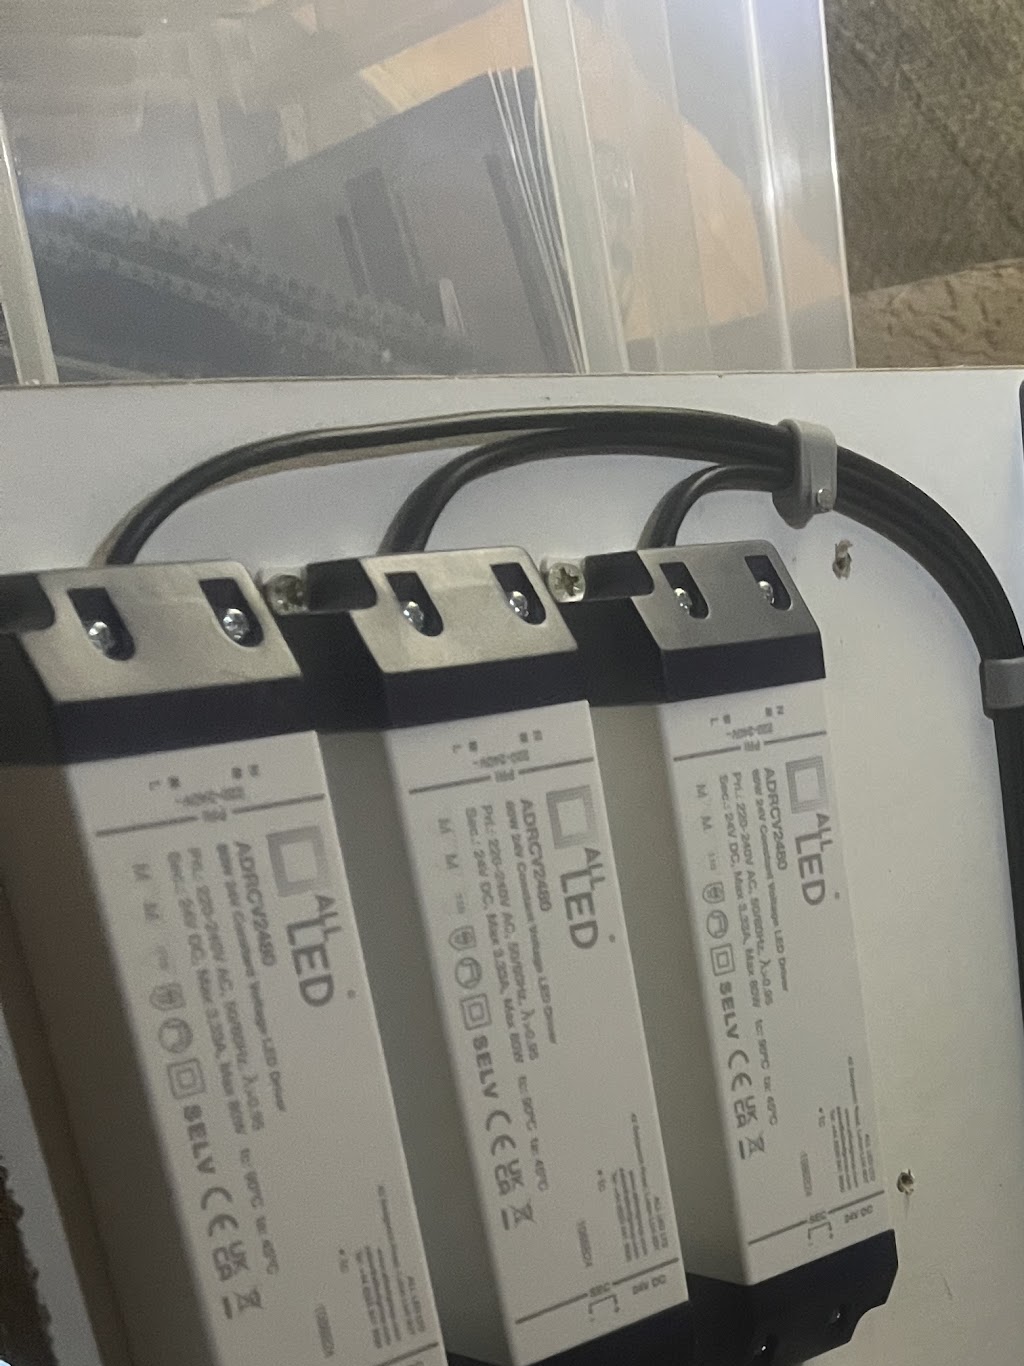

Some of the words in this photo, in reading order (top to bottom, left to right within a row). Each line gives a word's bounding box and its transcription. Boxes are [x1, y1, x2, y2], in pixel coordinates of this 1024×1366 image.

[735, 801, 753, 866] 220-240V
[764, 765, 788, 871] ADRCV2480
[815, 811, 833, 852] ALL
[520, 797, 552, 912] ADRCV2480
[584, 845, 606, 890] ALL
[758, 824, 773, 880] Constant
[795, 832, 828, 908] LED
[314, 892, 344, 943] ALL
[559, 868, 604, 953] LED
[724, 811, 736, 839] 24V
[743, 947, 756, 977] Max
[766, 882, 780, 927] Voltage
[285, 918, 341, 1010] LED
[773, 929, 783, 954] LED
[777, 956, 789, 993] Driver
[718, 980, 739, 1042] SELV
[471, 1034, 498, 1102] SELV
[744, 1094, 758, 1123] UK
[181, 1103, 216, 1178] SELV
